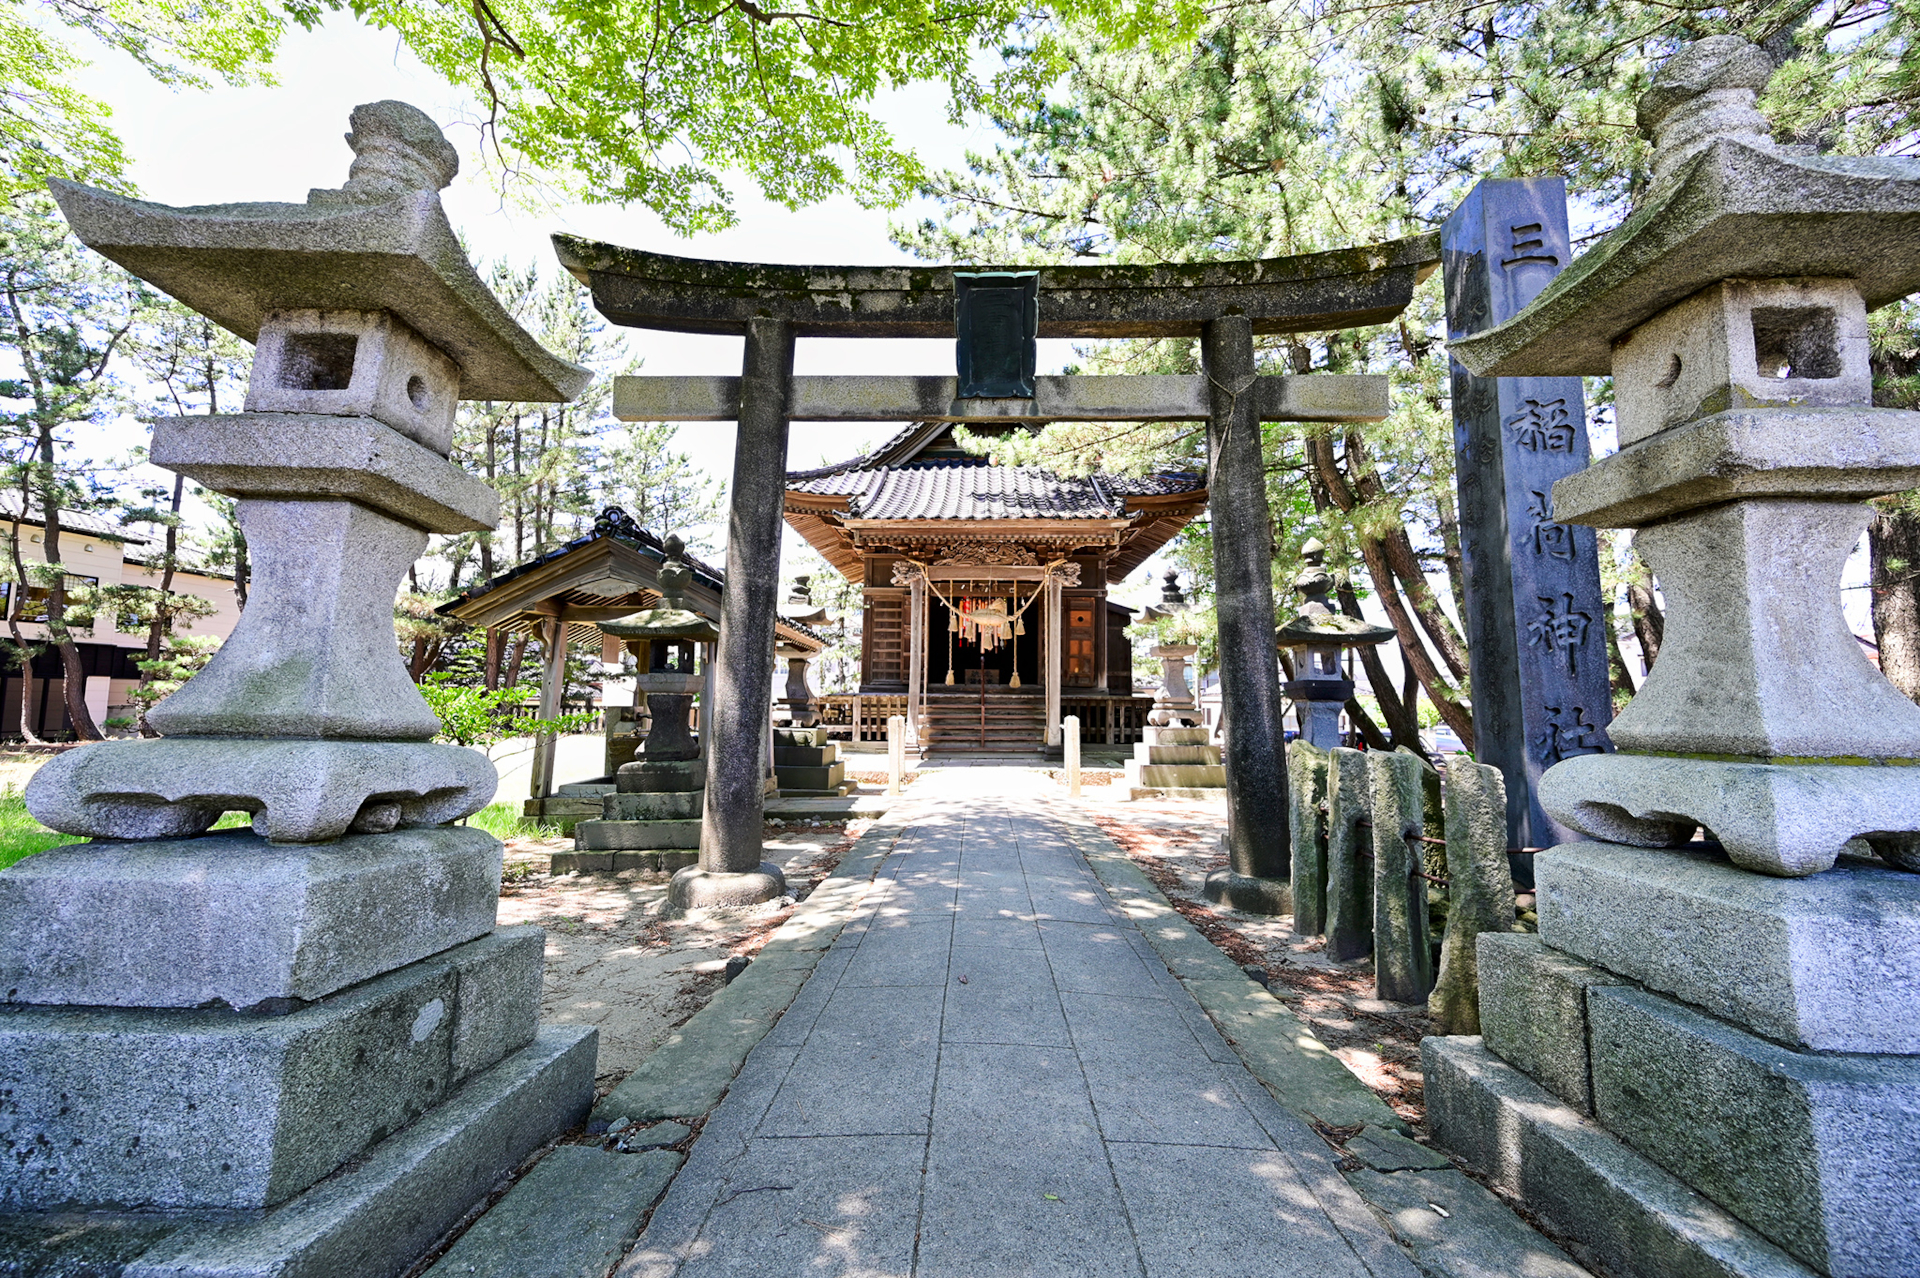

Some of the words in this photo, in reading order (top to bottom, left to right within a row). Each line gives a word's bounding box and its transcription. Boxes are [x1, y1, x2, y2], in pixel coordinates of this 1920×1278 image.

[1501, 222, 1605, 762] 三稲荷神社
